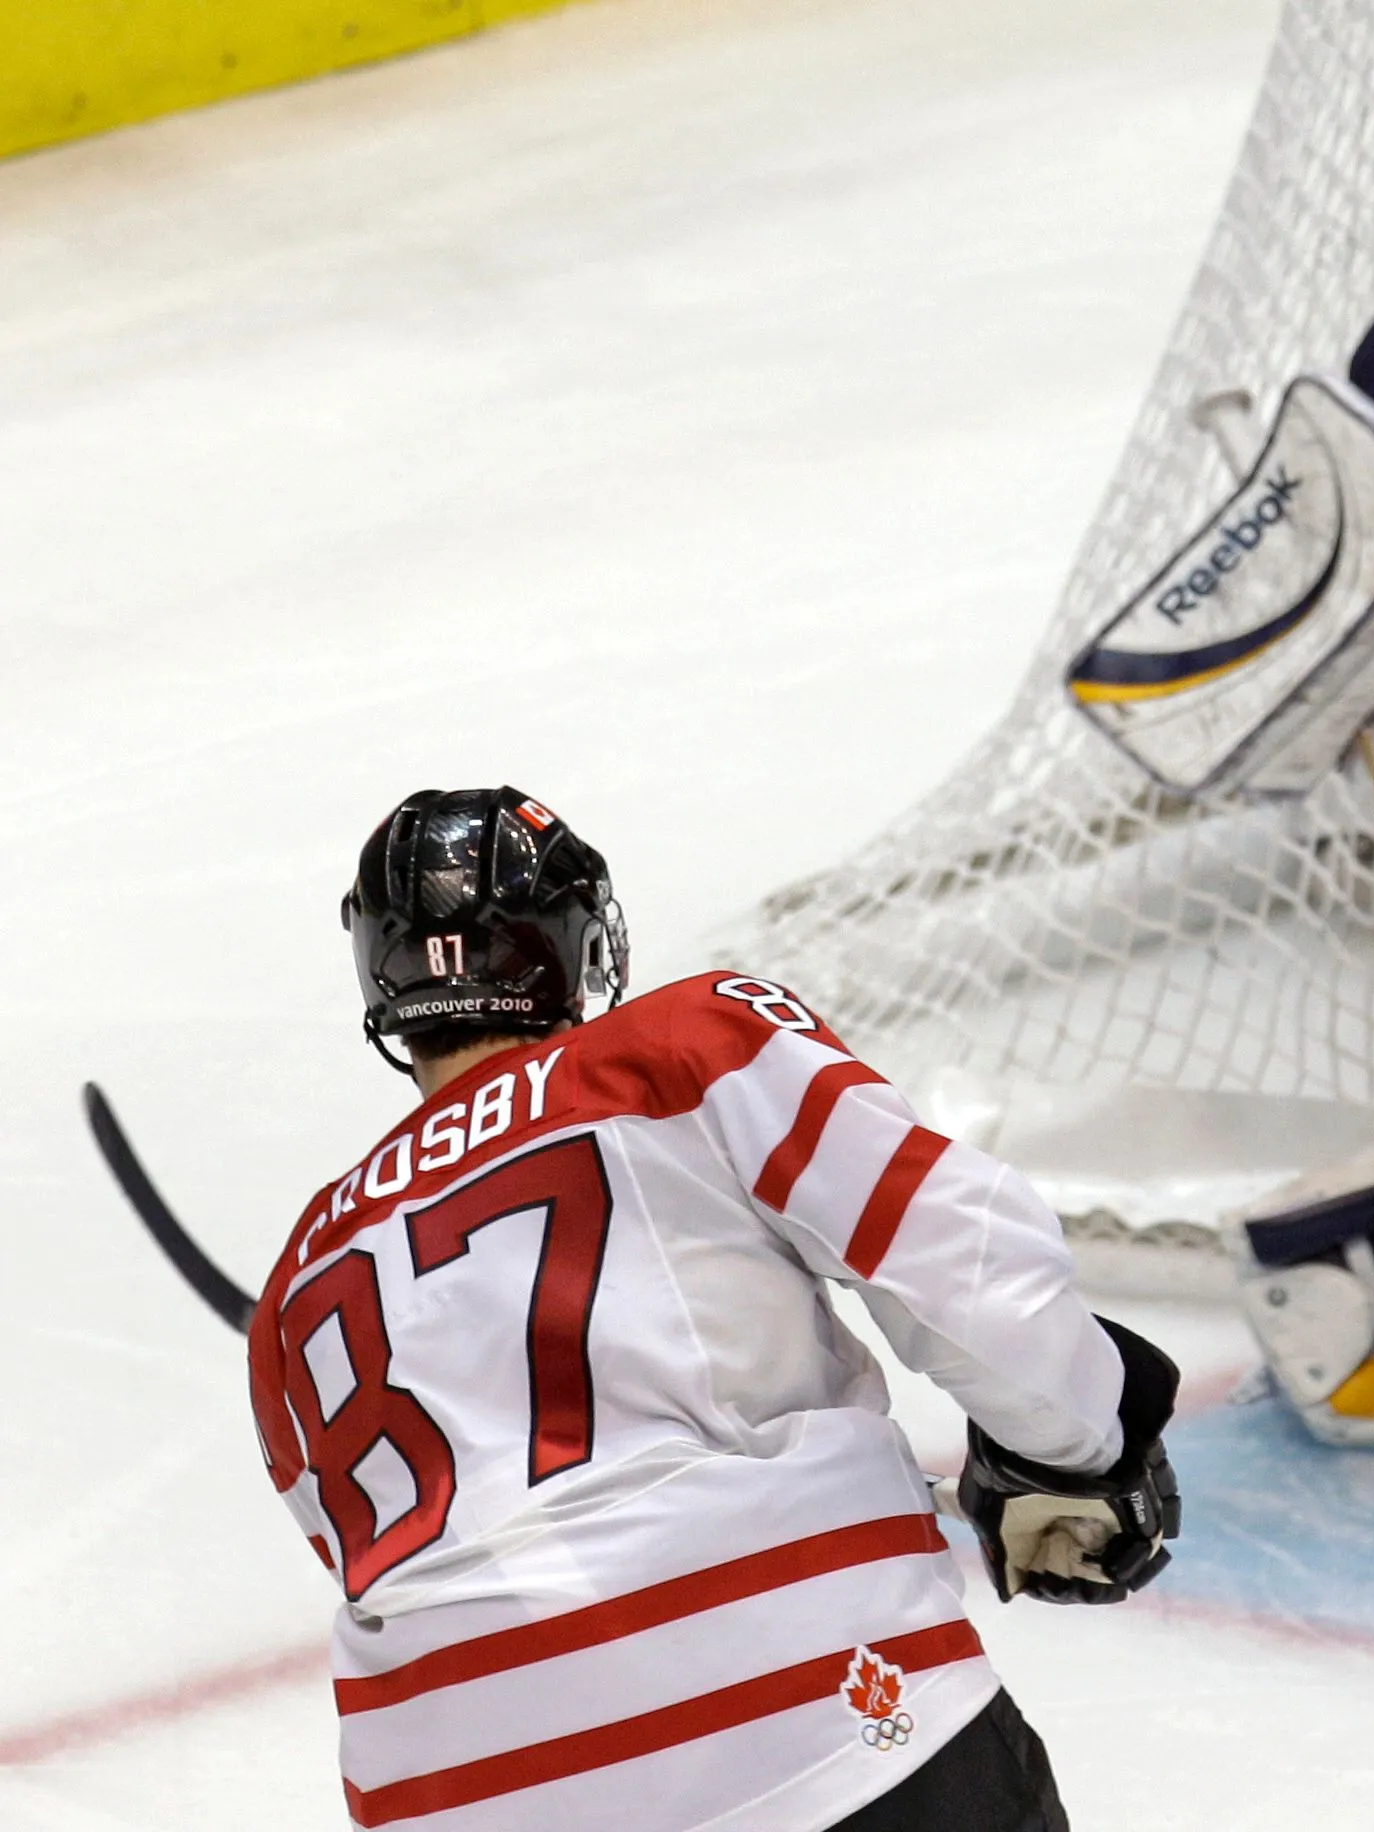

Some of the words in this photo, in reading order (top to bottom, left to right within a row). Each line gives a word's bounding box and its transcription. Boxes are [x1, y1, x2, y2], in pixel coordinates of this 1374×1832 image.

[1157, 467, 1303, 625] Reebok
[426, 934, 464, 976] 87
[397, 998, 485, 1020] vancouver
[490, 998, 533, 1012] 2010
[281, 1130, 613, 1603] 87
